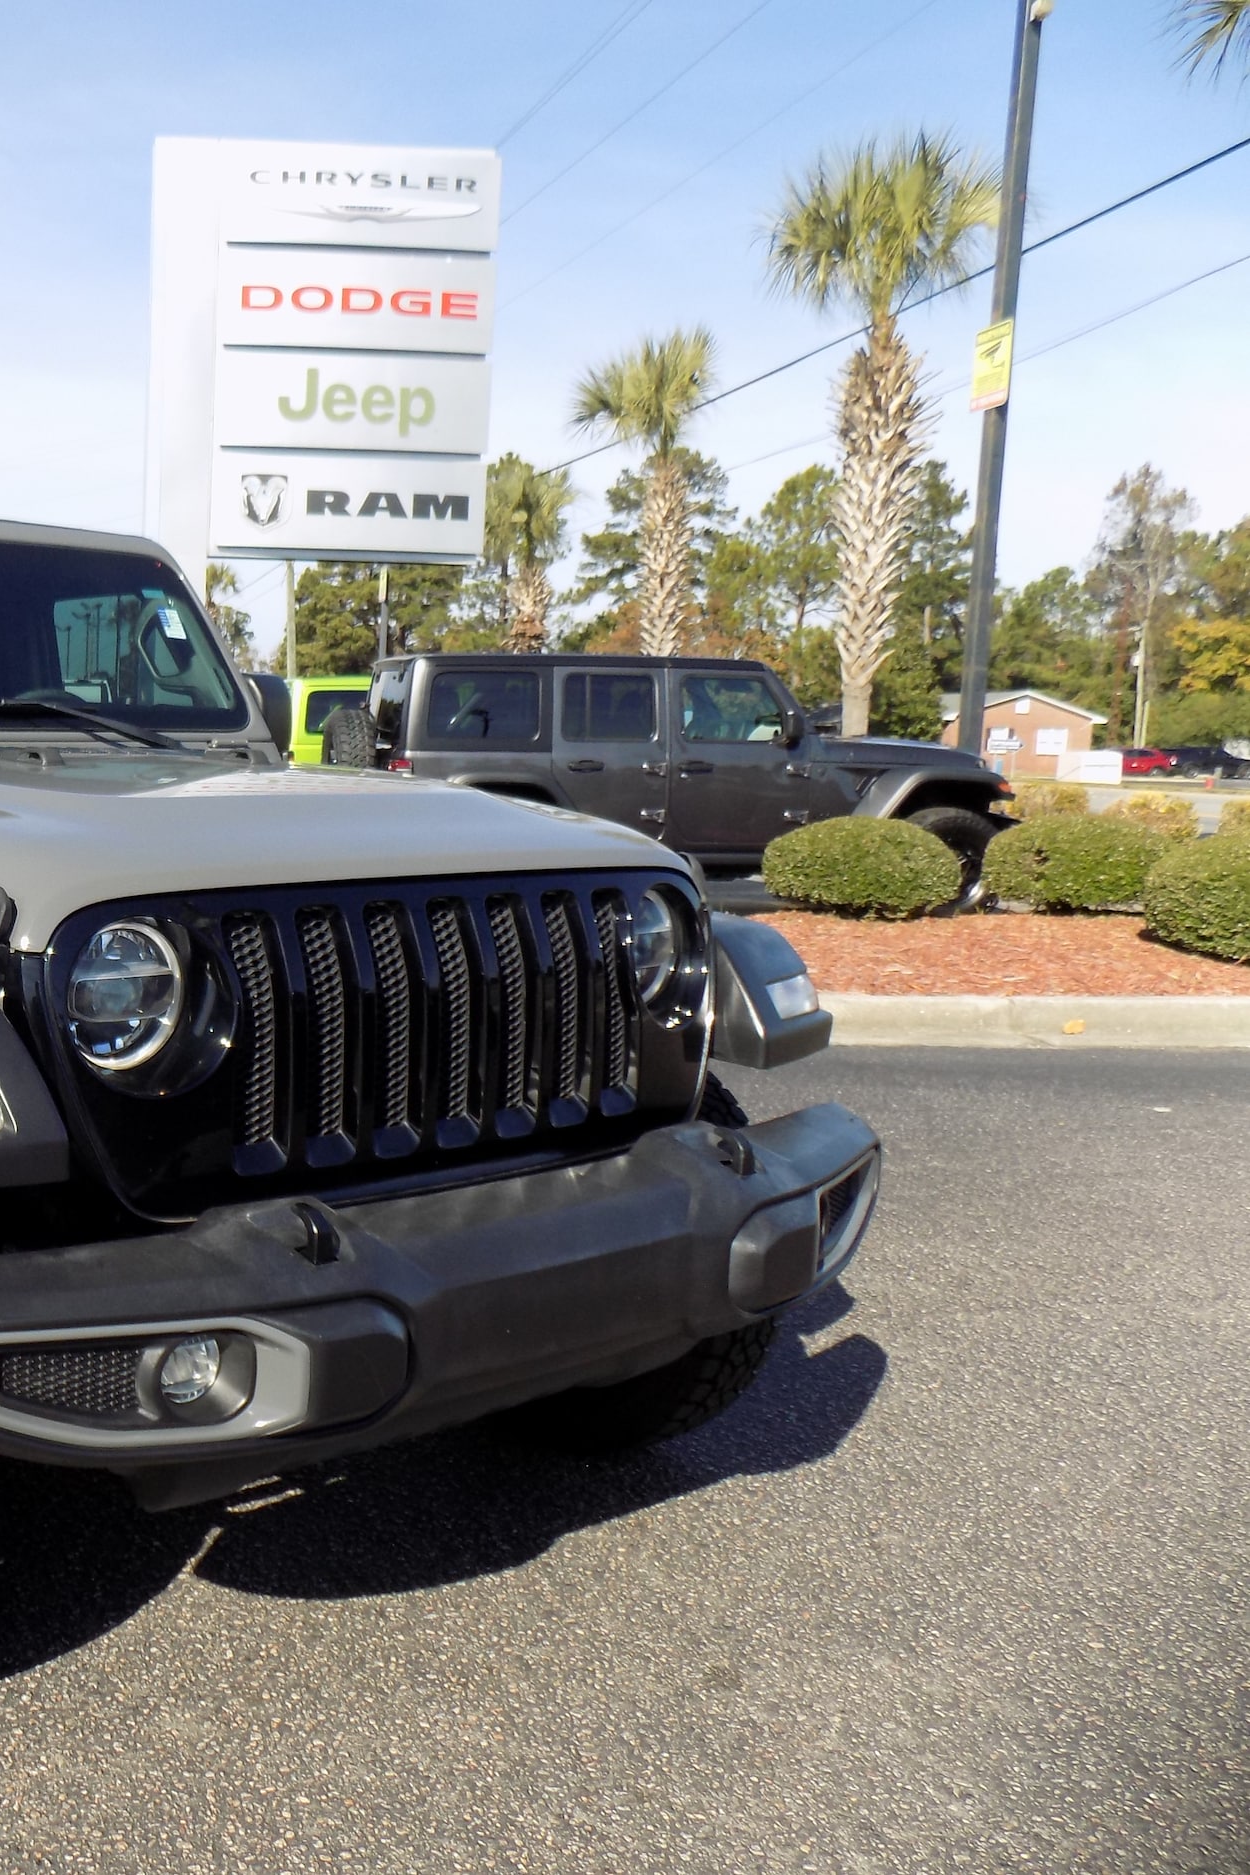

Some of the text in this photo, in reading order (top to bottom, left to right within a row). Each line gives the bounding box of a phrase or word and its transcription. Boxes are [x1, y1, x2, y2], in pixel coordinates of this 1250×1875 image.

[249, 170, 478, 193] CHRYSLER
[241, 285, 478, 320] DODGE
[278, 367, 436, 437] Jeep
[306, 489, 470, 521] RAM
